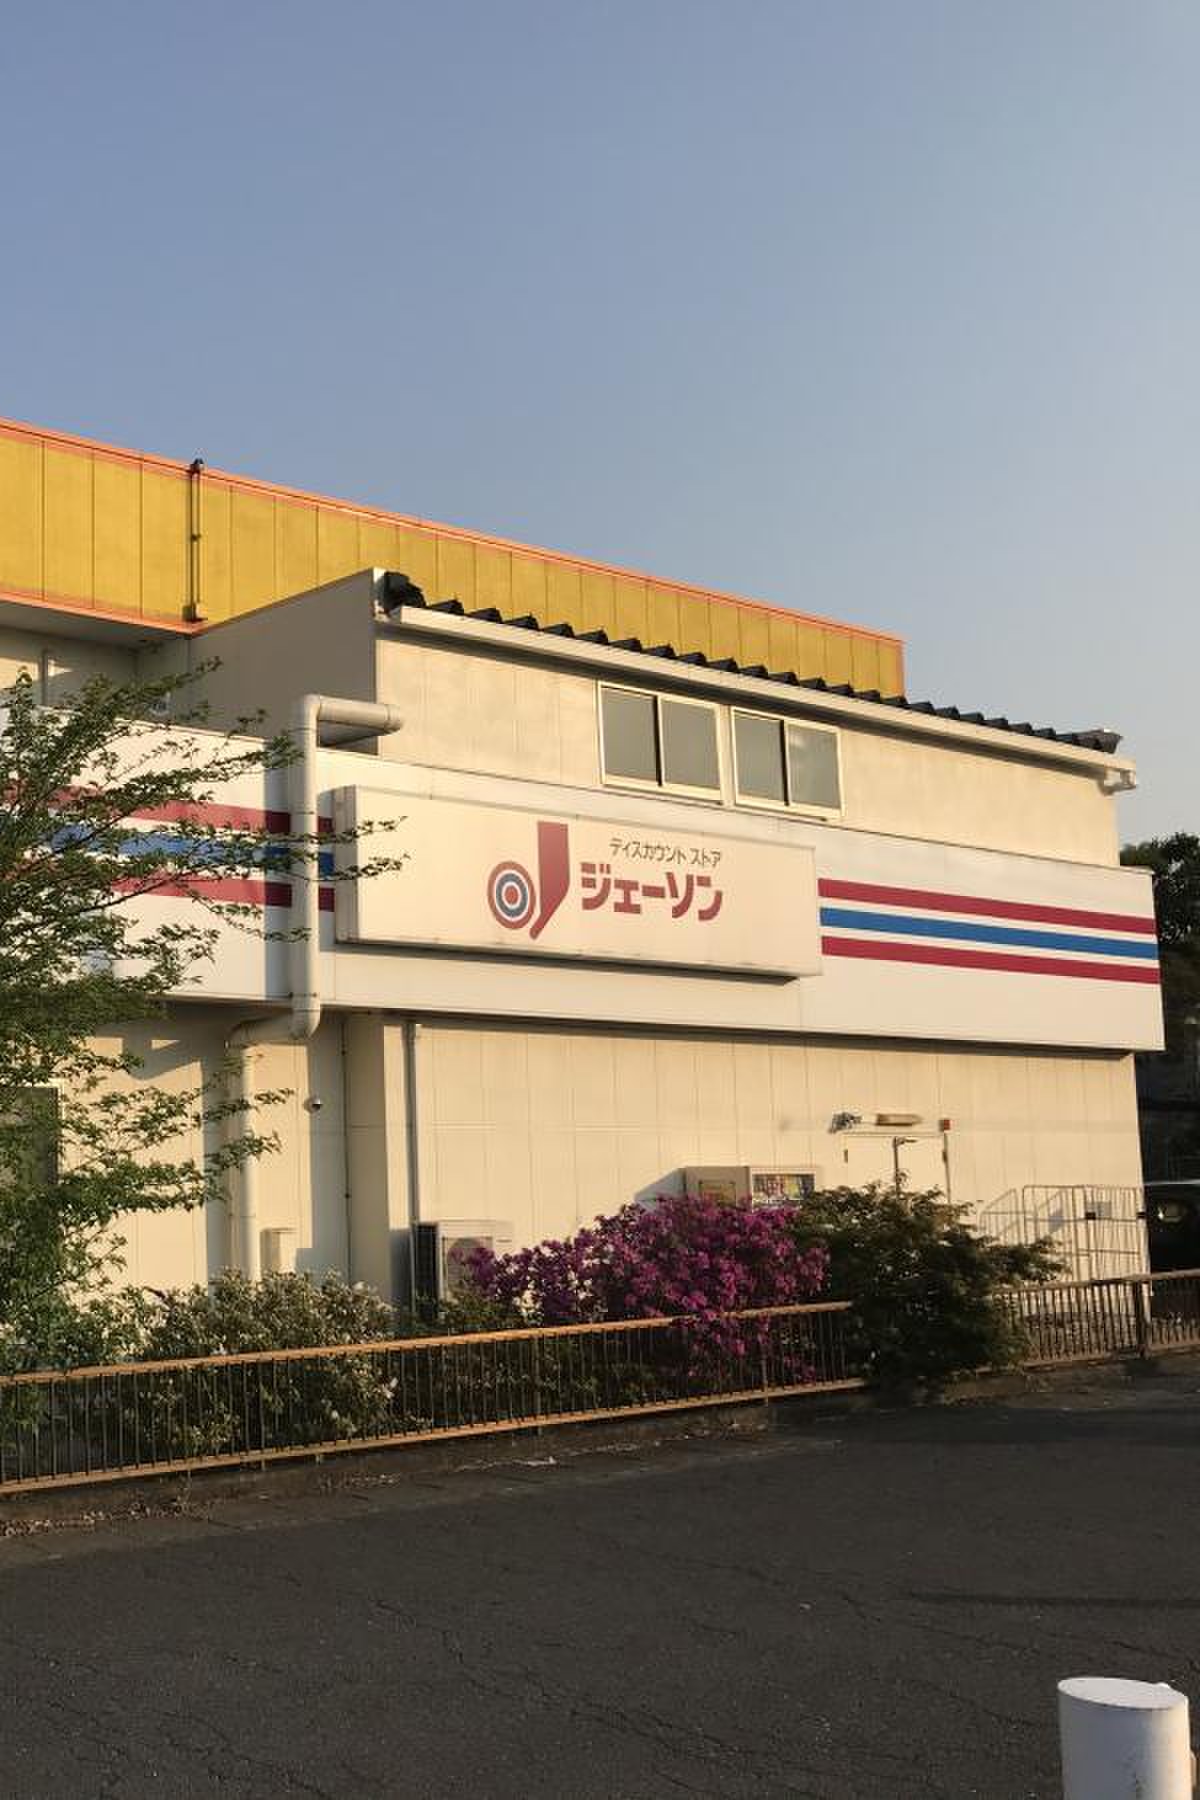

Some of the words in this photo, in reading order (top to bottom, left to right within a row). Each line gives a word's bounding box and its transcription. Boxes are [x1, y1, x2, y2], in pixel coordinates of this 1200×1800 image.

[689, 847, 721, 868] ストア
[580, 861, 723, 922] ジェーソン
